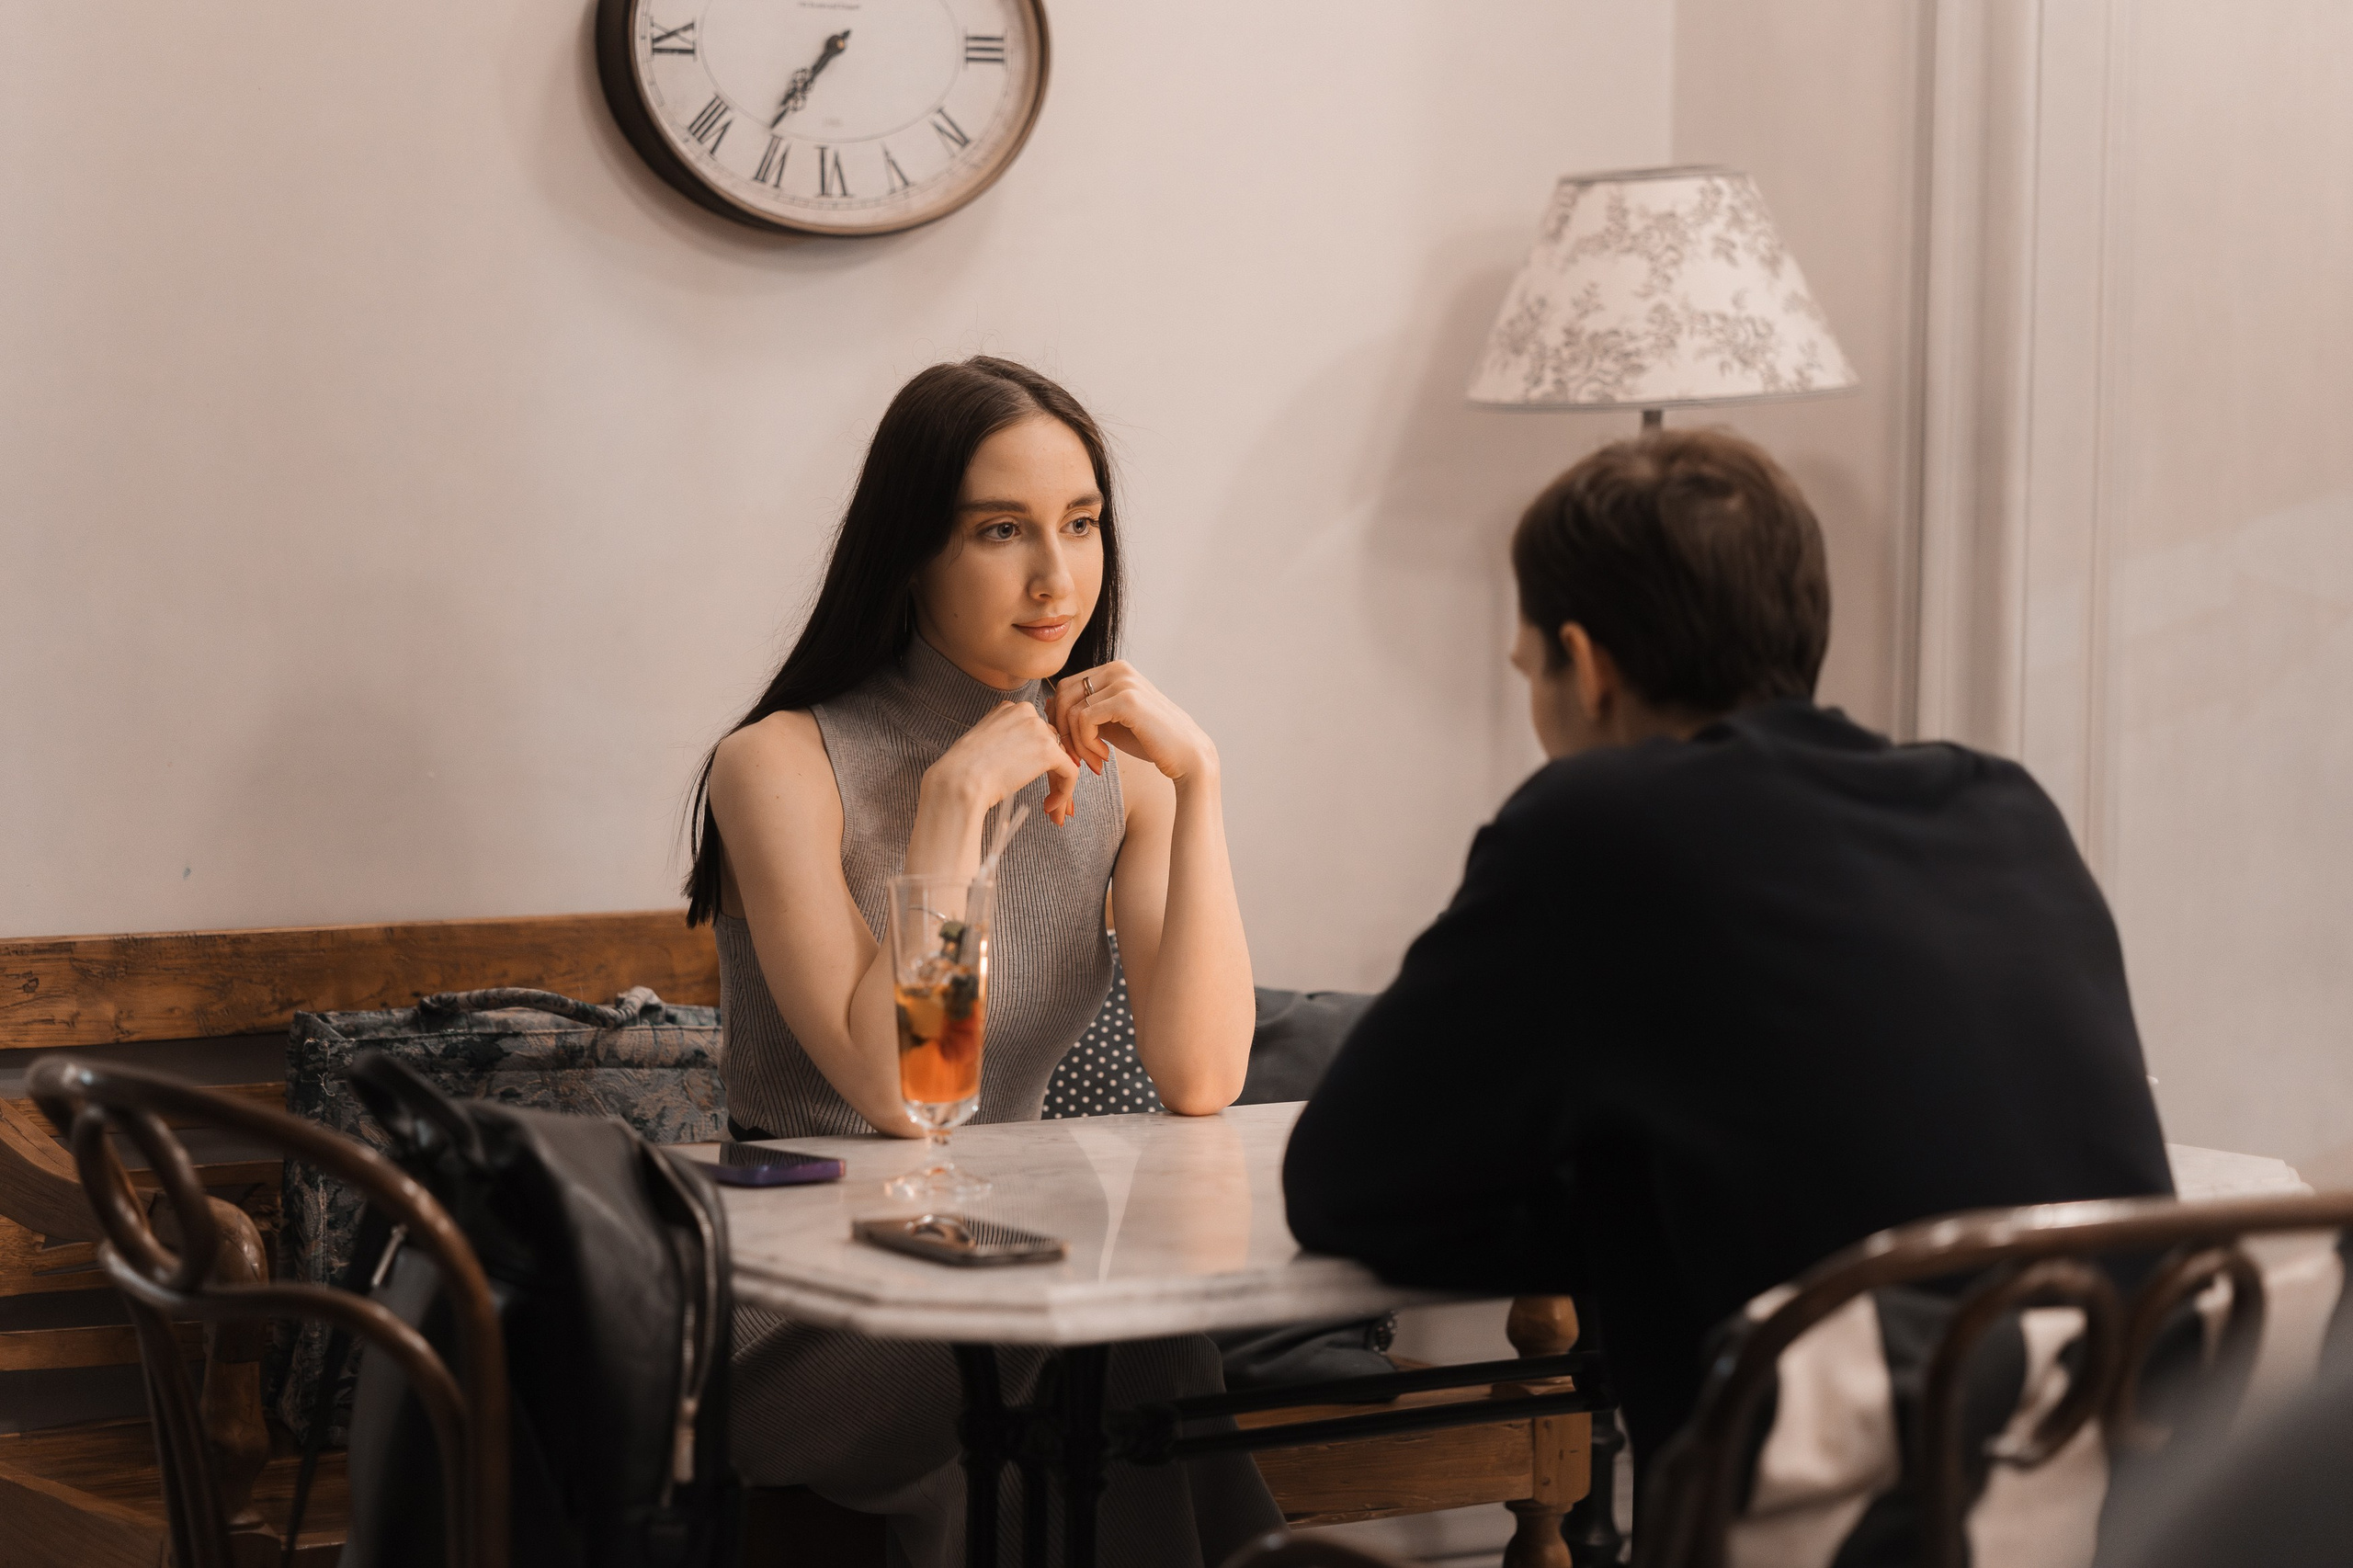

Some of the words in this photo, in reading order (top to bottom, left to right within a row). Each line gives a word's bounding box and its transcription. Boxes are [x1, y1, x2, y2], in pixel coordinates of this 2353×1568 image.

[650, 17, 698, 62] IX
[962, 28, 1008, 70] III
[688, 92, 735, 161] VIII
[752, 134, 793, 188] VII
[814, 145, 855, 198] VI
[879, 140, 917, 195] V
